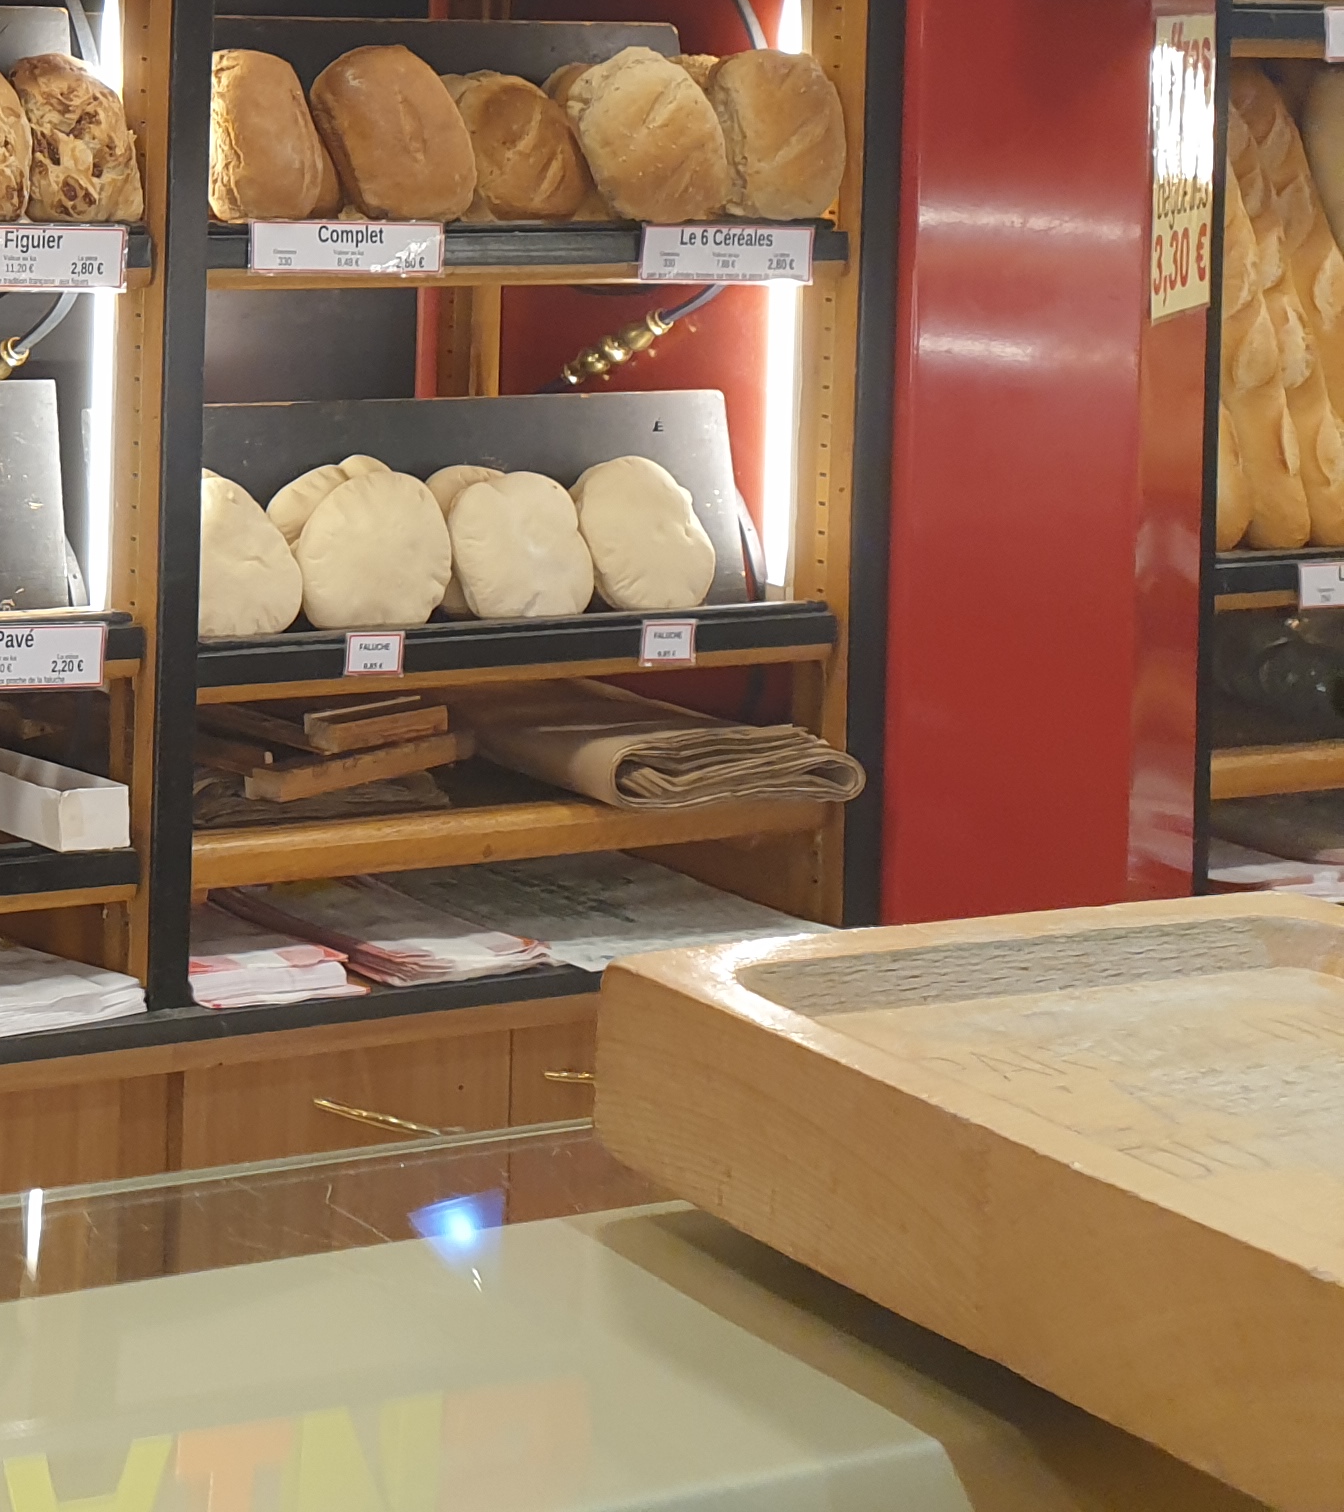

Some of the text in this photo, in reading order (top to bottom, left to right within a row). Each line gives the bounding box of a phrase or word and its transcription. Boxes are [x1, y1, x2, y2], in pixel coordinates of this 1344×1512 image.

[5, 229, 63, 253] Figuier
[318, 225, 384, 248] Complet
[680, 227, 773, 247] Le 6 Céréales
[71, 262, 104, 275] 2,80 €
[768, 259, 795, 271] 2,80 €
[1153, 222, 1207, 307] 3,30 €
[51, 660, 84, 675] 2,20 €
